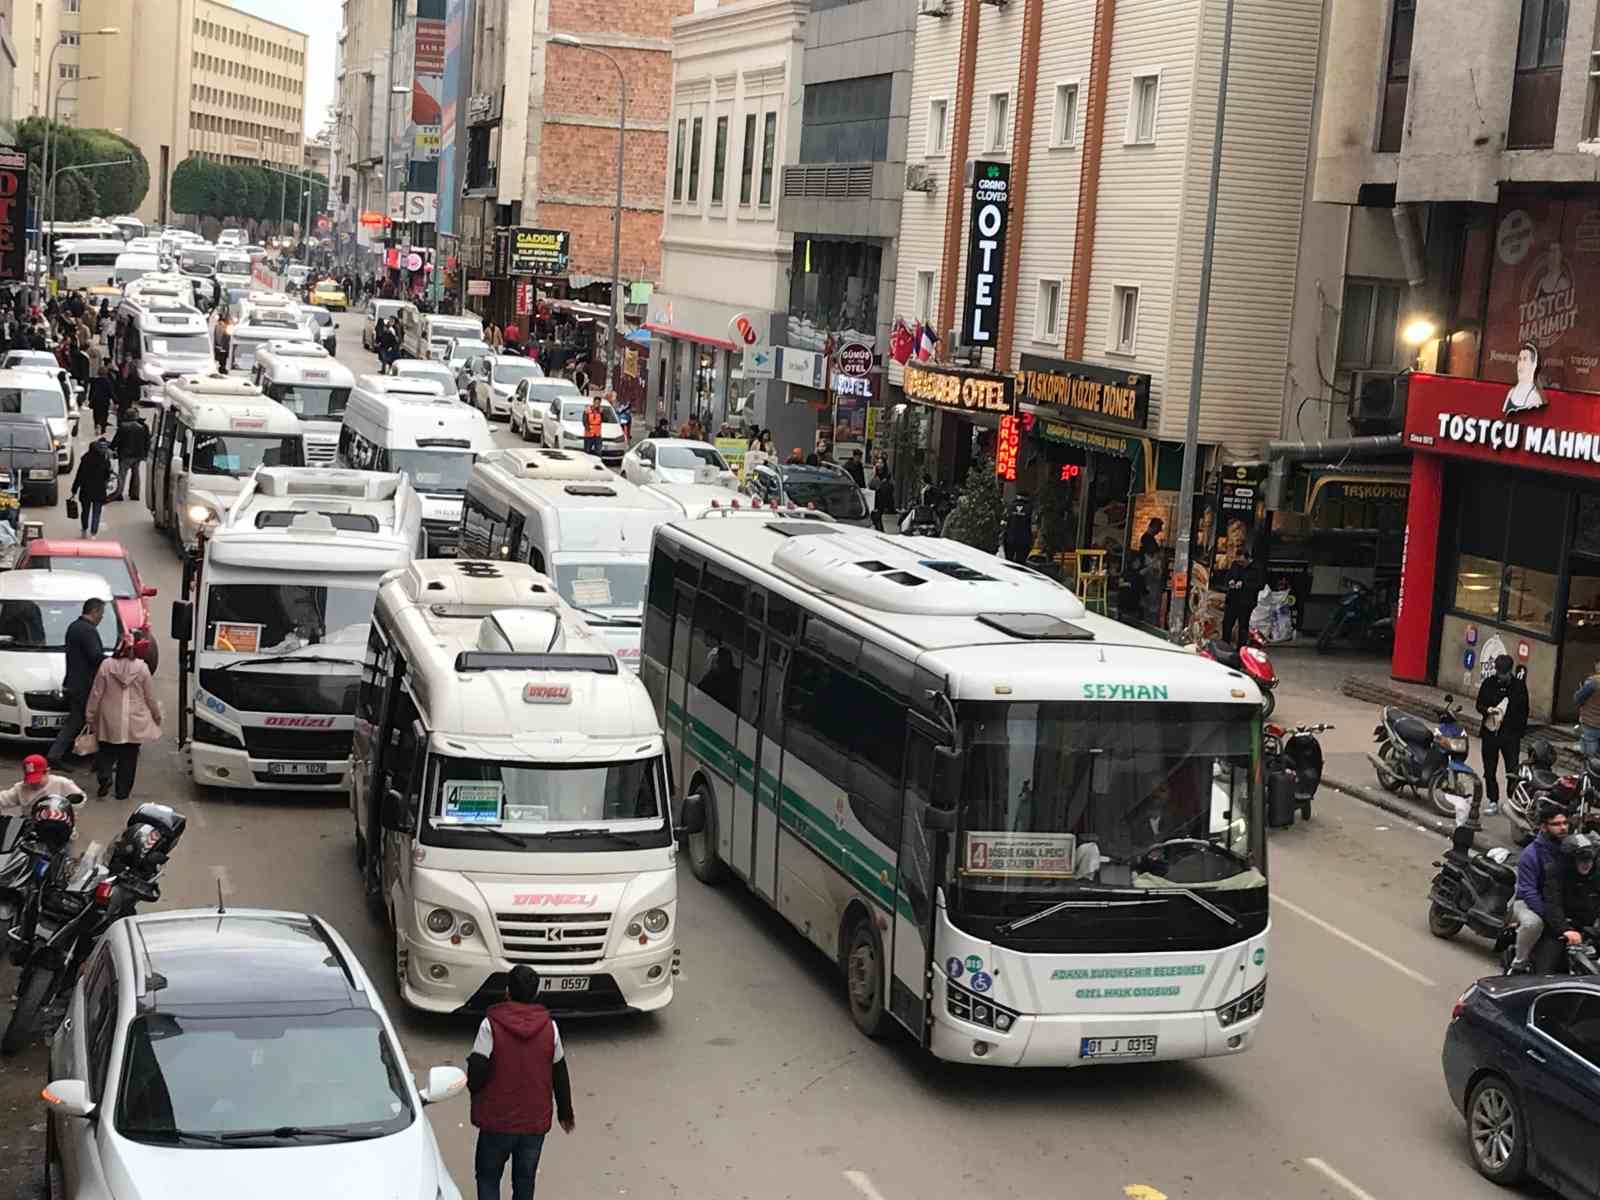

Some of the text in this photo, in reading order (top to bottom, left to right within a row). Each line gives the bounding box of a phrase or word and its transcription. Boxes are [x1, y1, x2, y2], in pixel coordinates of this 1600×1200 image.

[978, 179, 1007, 190] GRAND
[975, 190, 1008, 202] CLOVER
[517, 233, 555, 244] CADDE
[973, 204, 1001, 341] OTEL
[842, 350, 870, 361] GÜMÜŞ
[844, 364, 866, 373] OTEL
[962, 378, 1010, 411] OTEL
[1026, 368, 1137, 420] TAŞKÖPRÜ KÖZDE DÖNER
[1438, 412, 1520, 450] TOSTÇU
[998, 416, 1011, 473] GRAND
[1083, 683, 1168, 700] SEYHAN
[448, 786, 459, 807] 4
[972, 843, 986, 867] 4
[1051, 969, 1089, 980] ADANA
[544, 977, 588, 990] M 0597
[1103, 988, 1132, 998] HALK
[1088, 1038, 1154, 1053] 01 J 0315
